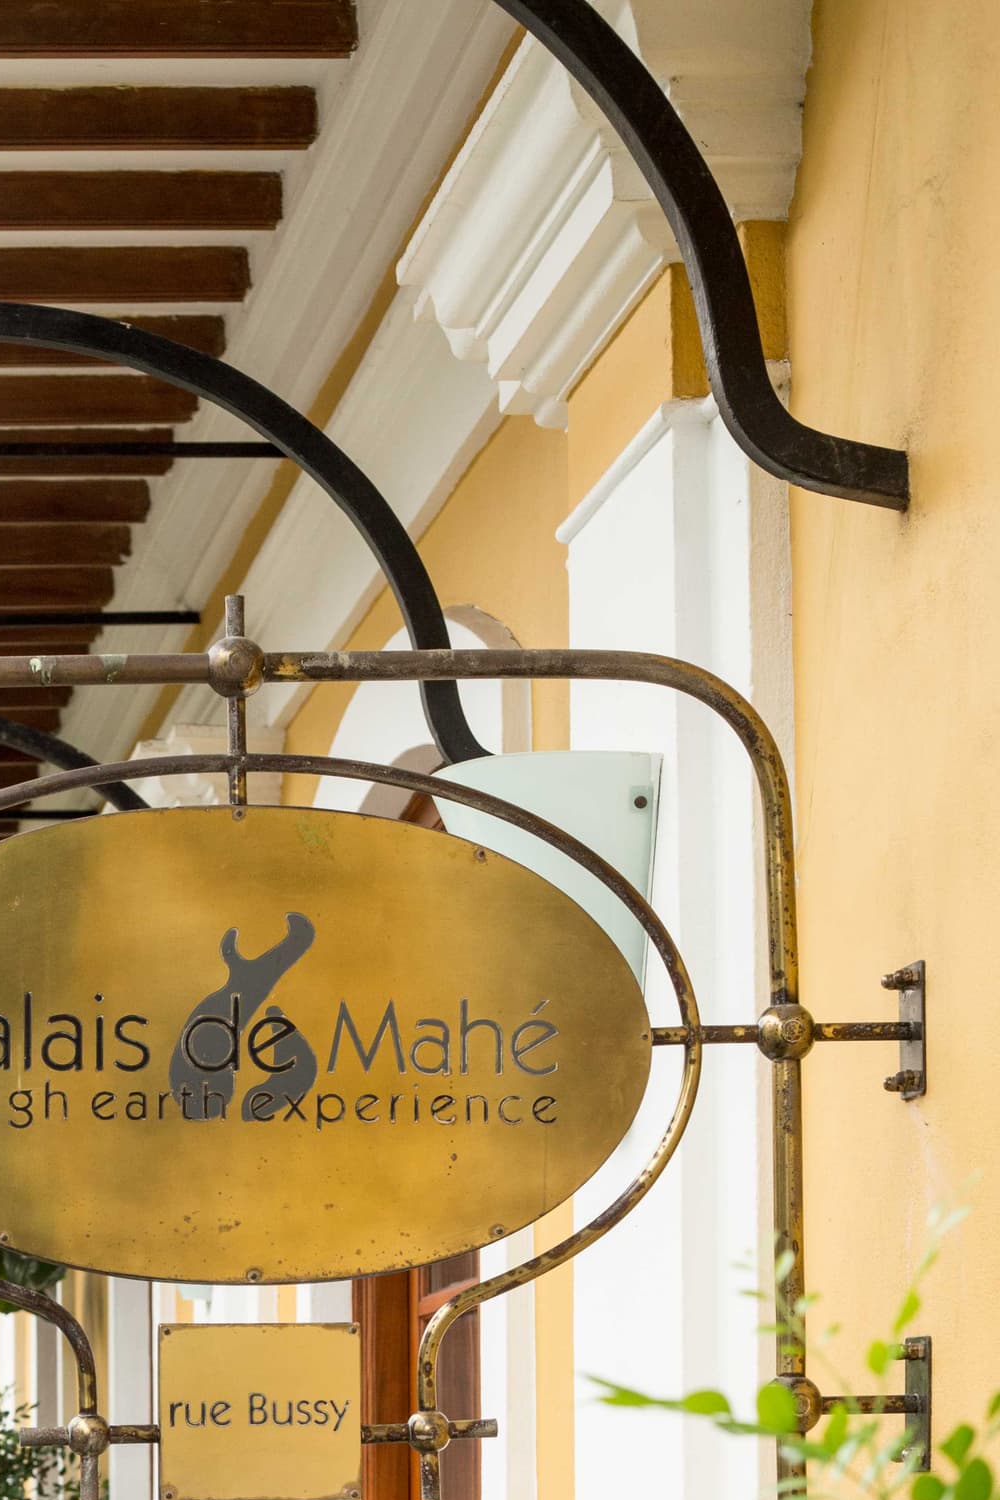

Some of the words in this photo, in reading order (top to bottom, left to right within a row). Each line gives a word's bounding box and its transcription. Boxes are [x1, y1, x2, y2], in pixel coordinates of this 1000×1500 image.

[181, 993, 297, 1074] de
[327, 997, 559, 1076] Mahé
[91, 1081, 228, 1122] earth
[249, 1082, 558, 1133] experience
[169, 1400, 231, 1427] rue
[247, 1392, 351, 1431] Bussy
